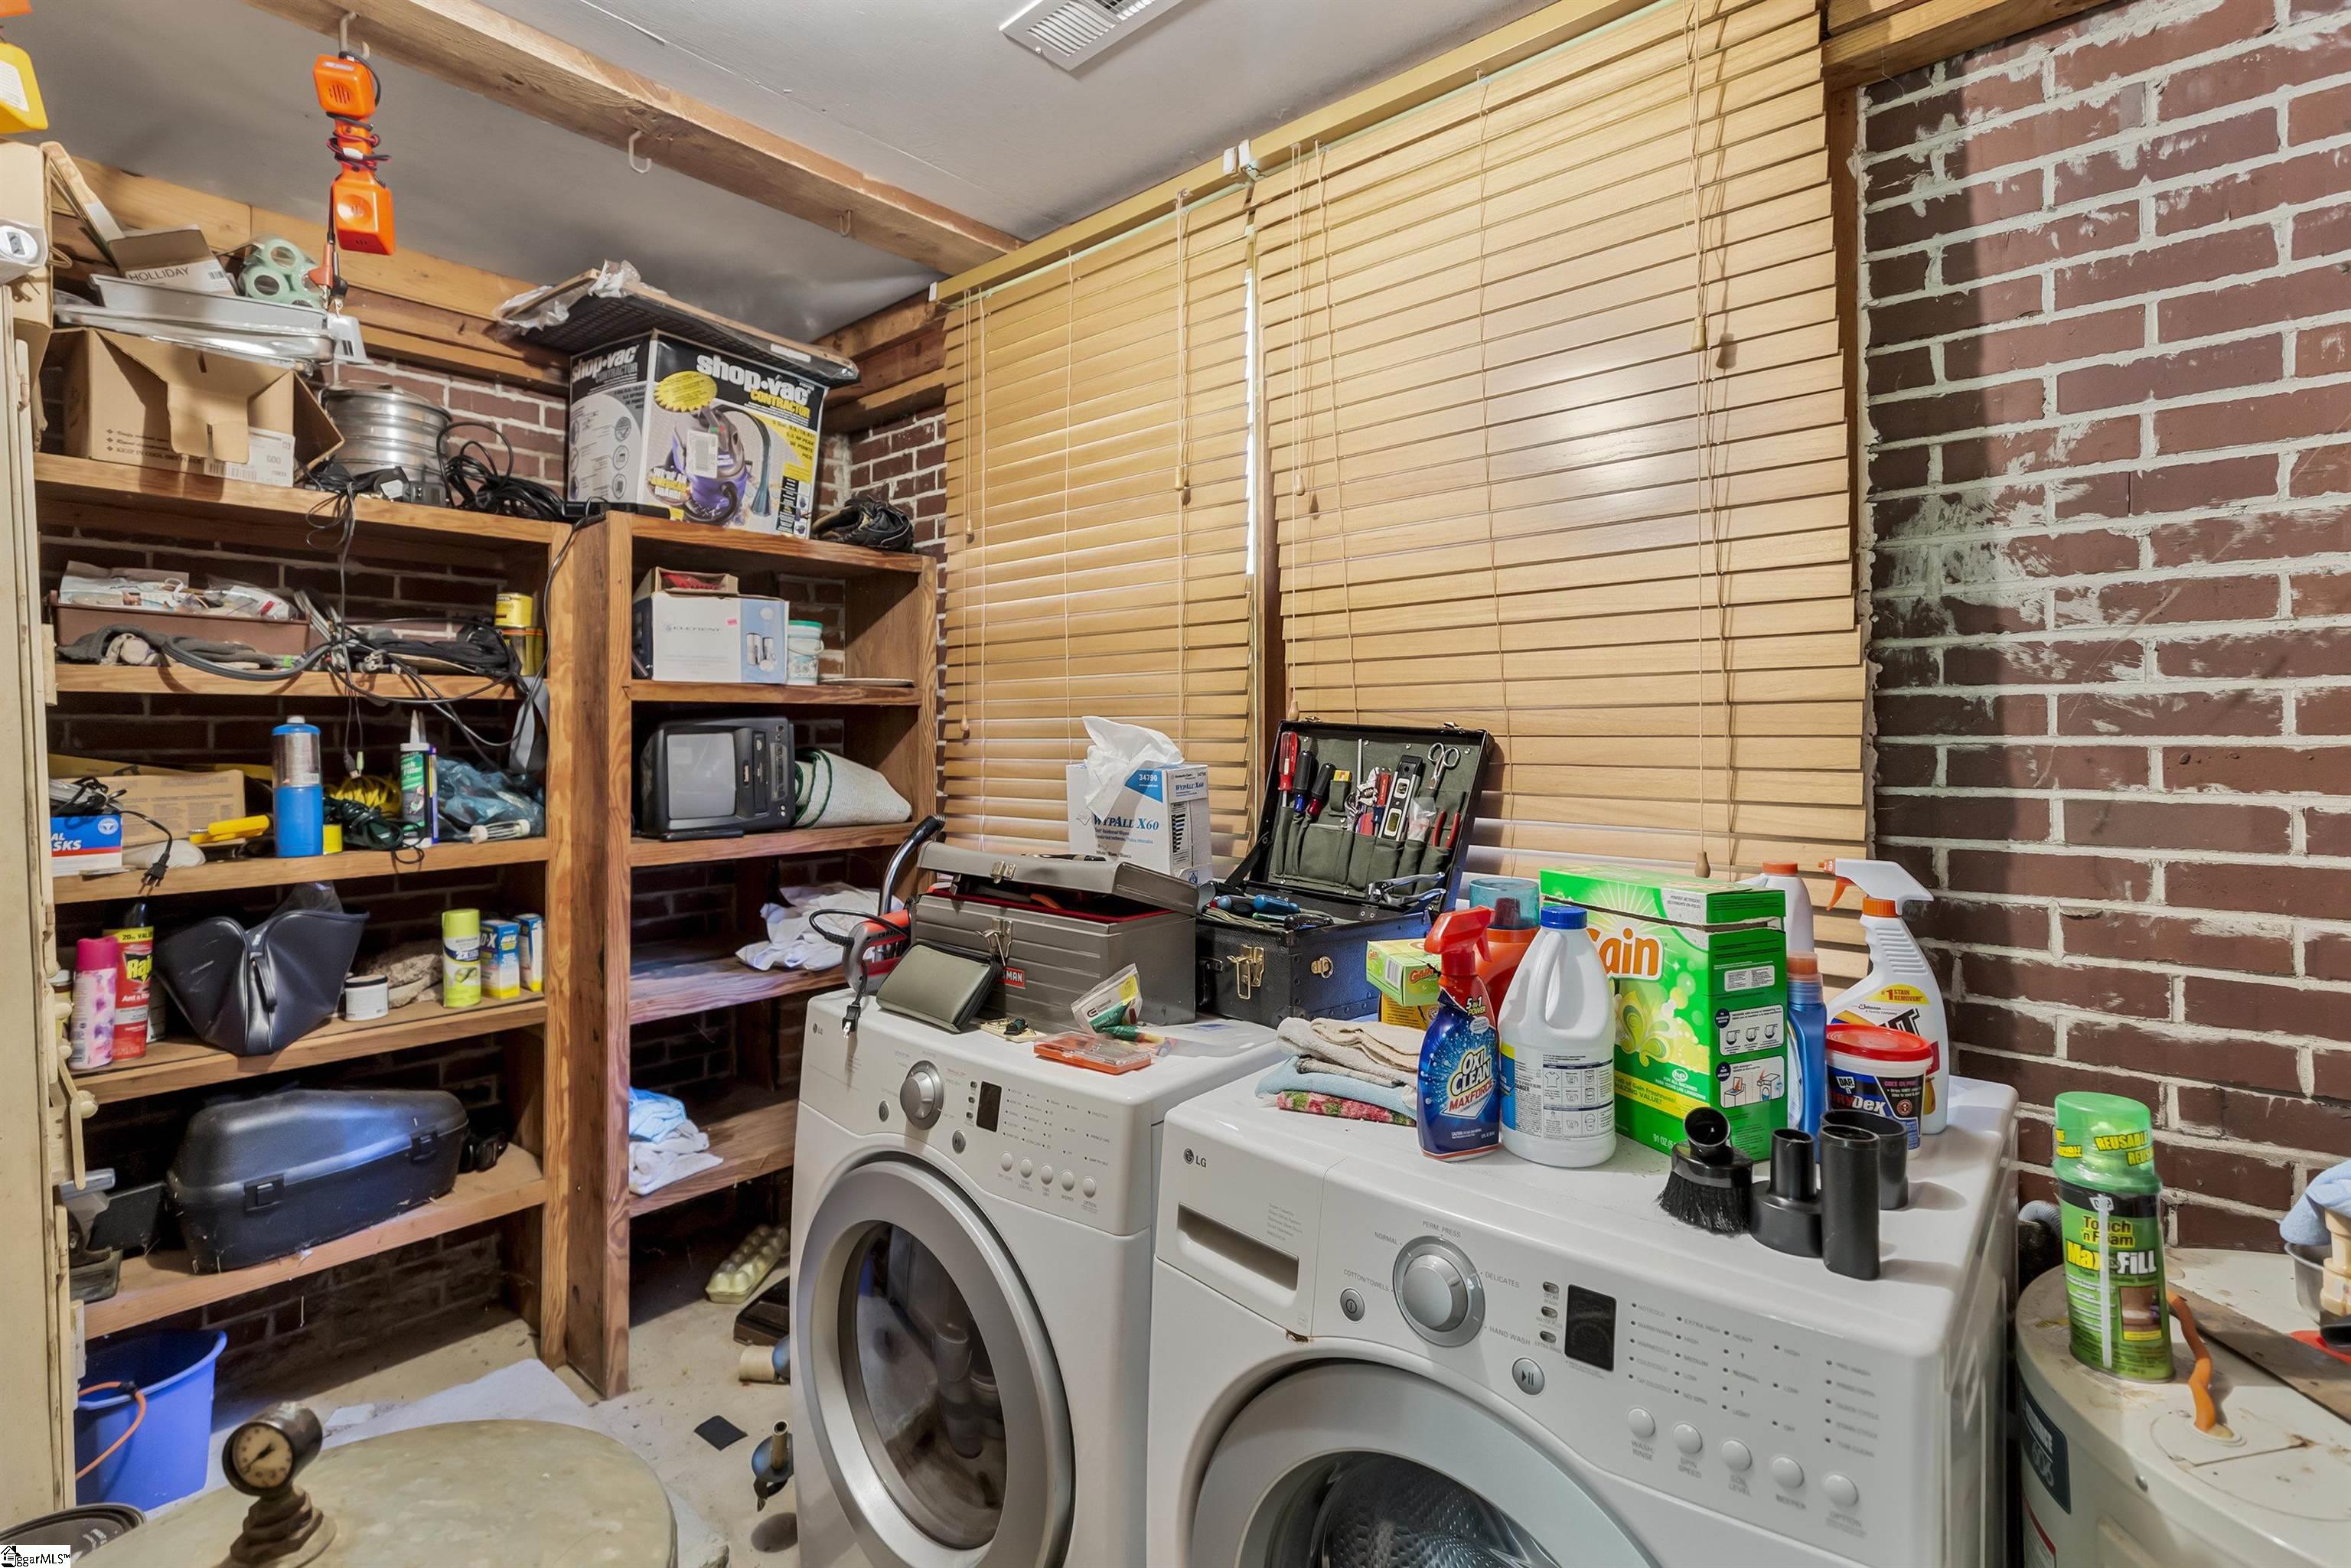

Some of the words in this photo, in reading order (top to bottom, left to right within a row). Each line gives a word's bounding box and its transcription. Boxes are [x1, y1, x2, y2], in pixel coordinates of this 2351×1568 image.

[128, 267, 189, 282] HOLLIDAY
[750, 389, 810, 418] CONTRACTOR
[1138, 774, 1158, 782] 34790
[1136, 817, 1160, 831] X60
[51, 832, 66, 841] AL
[52, 839, 82, 852] SKS
[1586, 927, 1661, 977] ain
[1466, 997, 1473, 1009] 5
[1477, 996, 1482, 1007] 1
[1468, 1005, 1487, 1016] POWER
[1461, 1047, 1485, 1076] OXI
[1449, 1057, 1492, 1097] CLEAN
[1632, 1082, 1645, 1091] Gain
[1448, 1077, 1494, 1113] MAXFORCE
[1195, 1156, 1207, 1168] LG
[1374, 1231, 1398, 1246] NORMAL
[1442, 1226, 1462, 1239] PRESS
[2093, 1231, 2134, 1247] Fam
[1343, 1269, 1390, 1293] COTTON/TOWELS
[1485, 1270, 1520, 1289] DELICATES
[1684, 1318, 1704, 1329] EXTRA
[1704, 1323, 1720, 1333] HIGH
[1489, 1325, 1509, 1338] HAND
[1508, 1333, 1531, 1346] WASH
[1684, 1354, 1709, 1368] MEDIUM
[1632, 1448, 1654, 1462] RINSE
[1680, 1456, 1698, 1469] SPIN
[1678, 1464, 1702, 1479] SPEED
[1730, 1474, 1748, 1488] SOIL
[1728, 1483, 1752, 1498] LEVEL
[1775, 1493, 1807, 1511] BEEPER
[1828, 1510, 1862, 1528] OPTION
